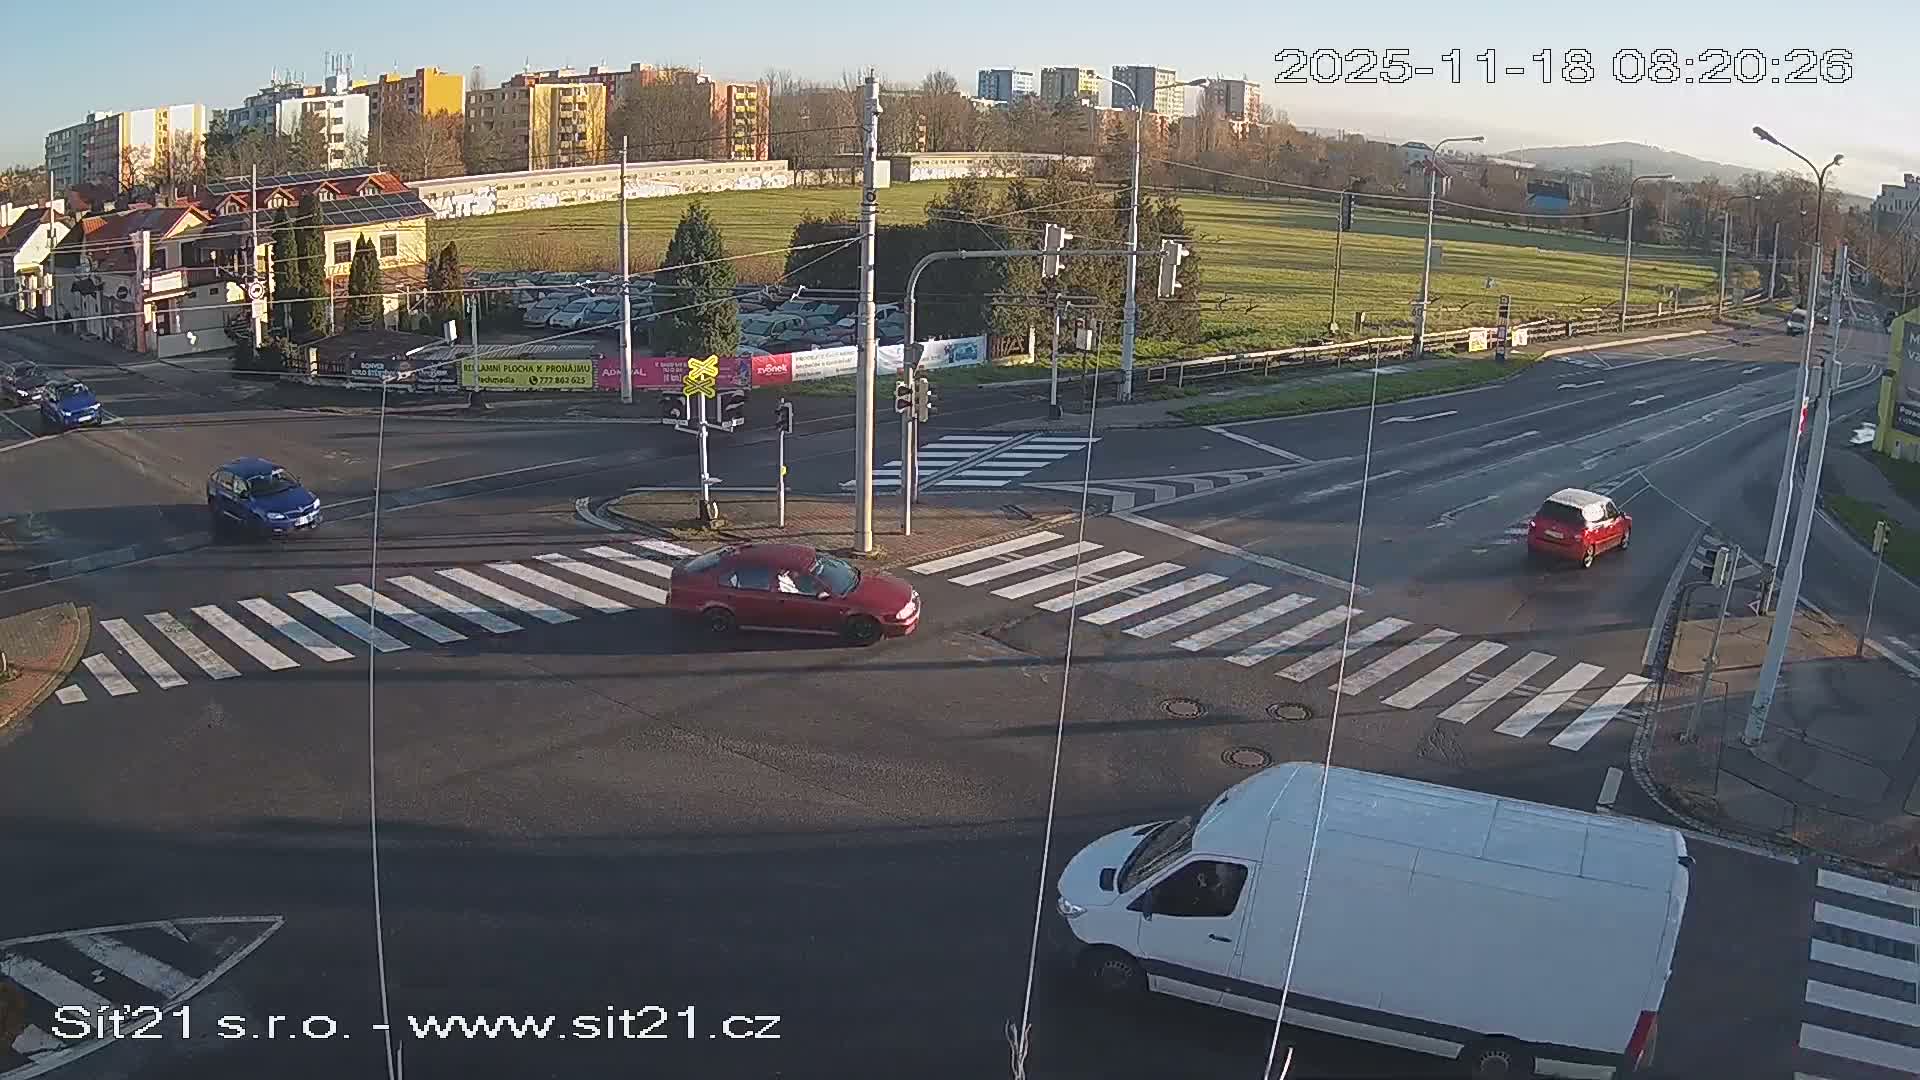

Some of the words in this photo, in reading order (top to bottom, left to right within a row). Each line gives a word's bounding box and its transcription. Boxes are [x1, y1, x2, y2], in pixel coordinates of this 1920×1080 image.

[463, 363, 501, 373] RELAMNÍ
[503, 364, 534, 374] PLOCHA
[537, 364, 543, 373] K
[545, 362, 590, 374] PRONÁJMU
[478, 375, 515, 385] echmedia
